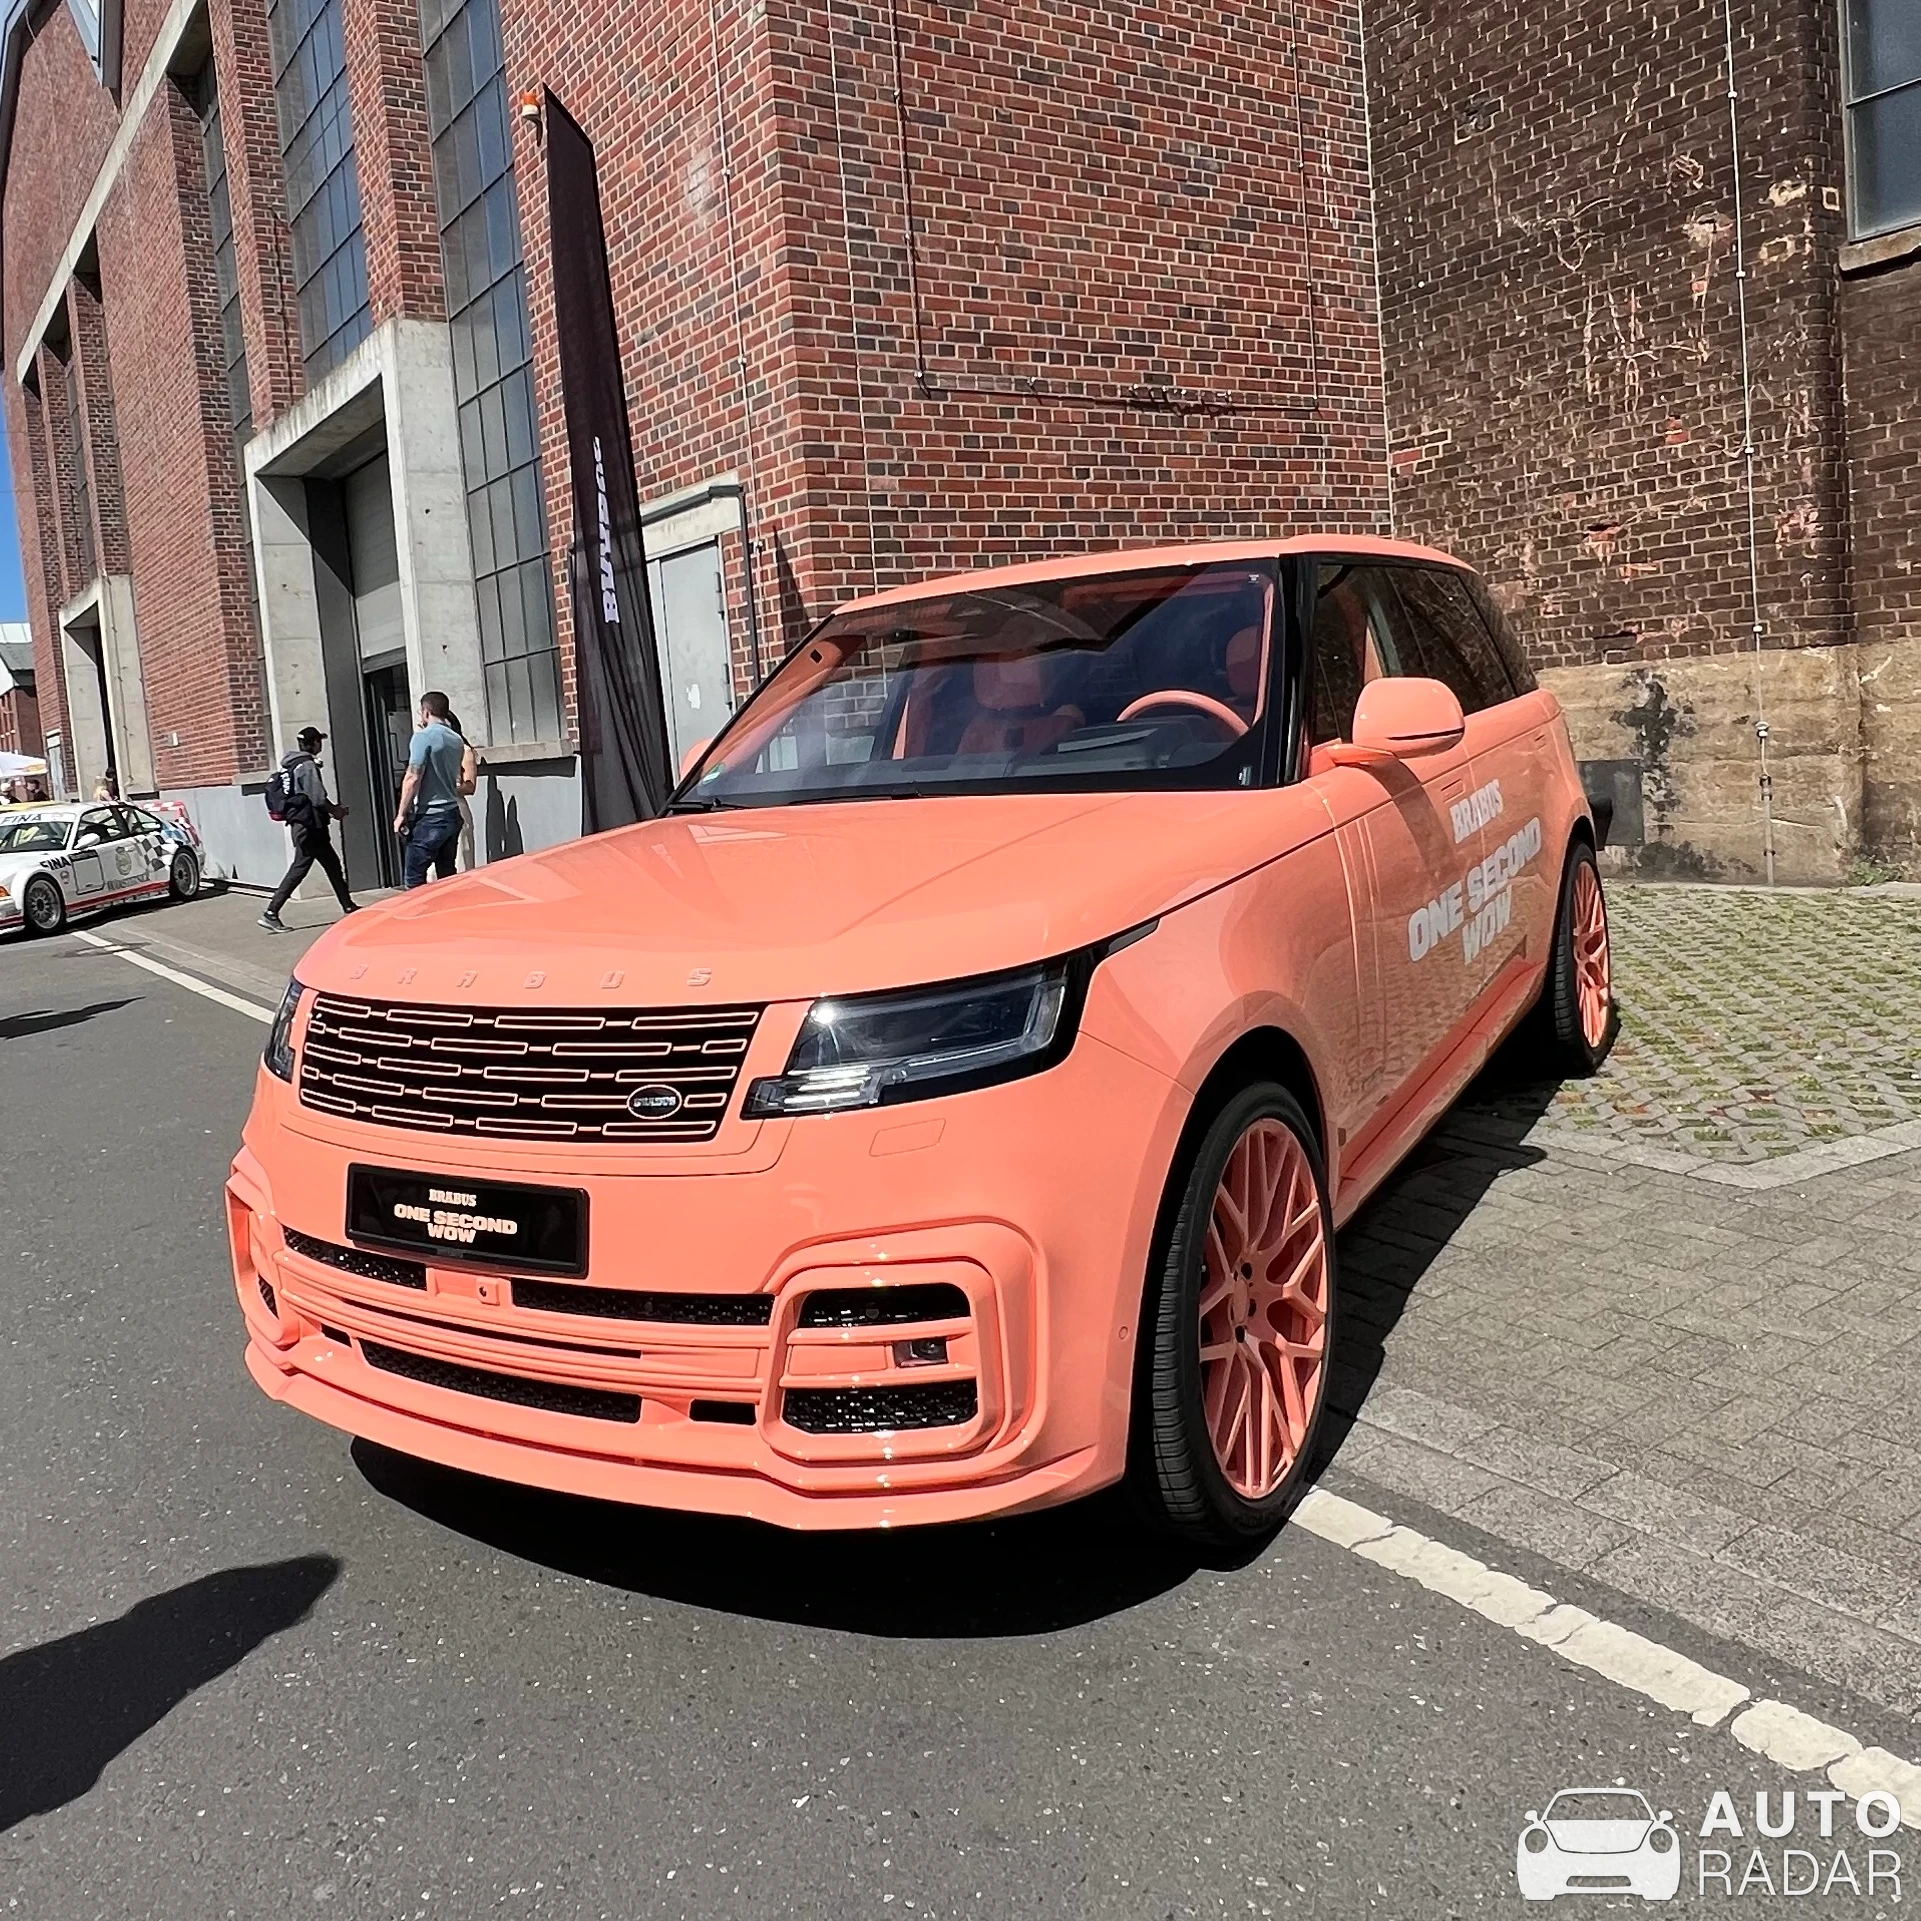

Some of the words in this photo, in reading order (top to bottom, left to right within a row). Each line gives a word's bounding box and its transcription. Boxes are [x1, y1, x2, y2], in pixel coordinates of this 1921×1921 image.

[1, 813, 42, 825] FINA
[1449, 779, 1503, 844] BRABUS
[1408, 879, 1464, 962] ONE
[1467, 817, 1542, 912] SECOND
[1461, 884, 1512, 966] WOW
[429, 1188, 477, 1207] BRABUS
[394, 1203, 431, 1222] ONE
[433, 1210, 518, 1235] SECOND
[427, 1222, 477, 1243] WOW
